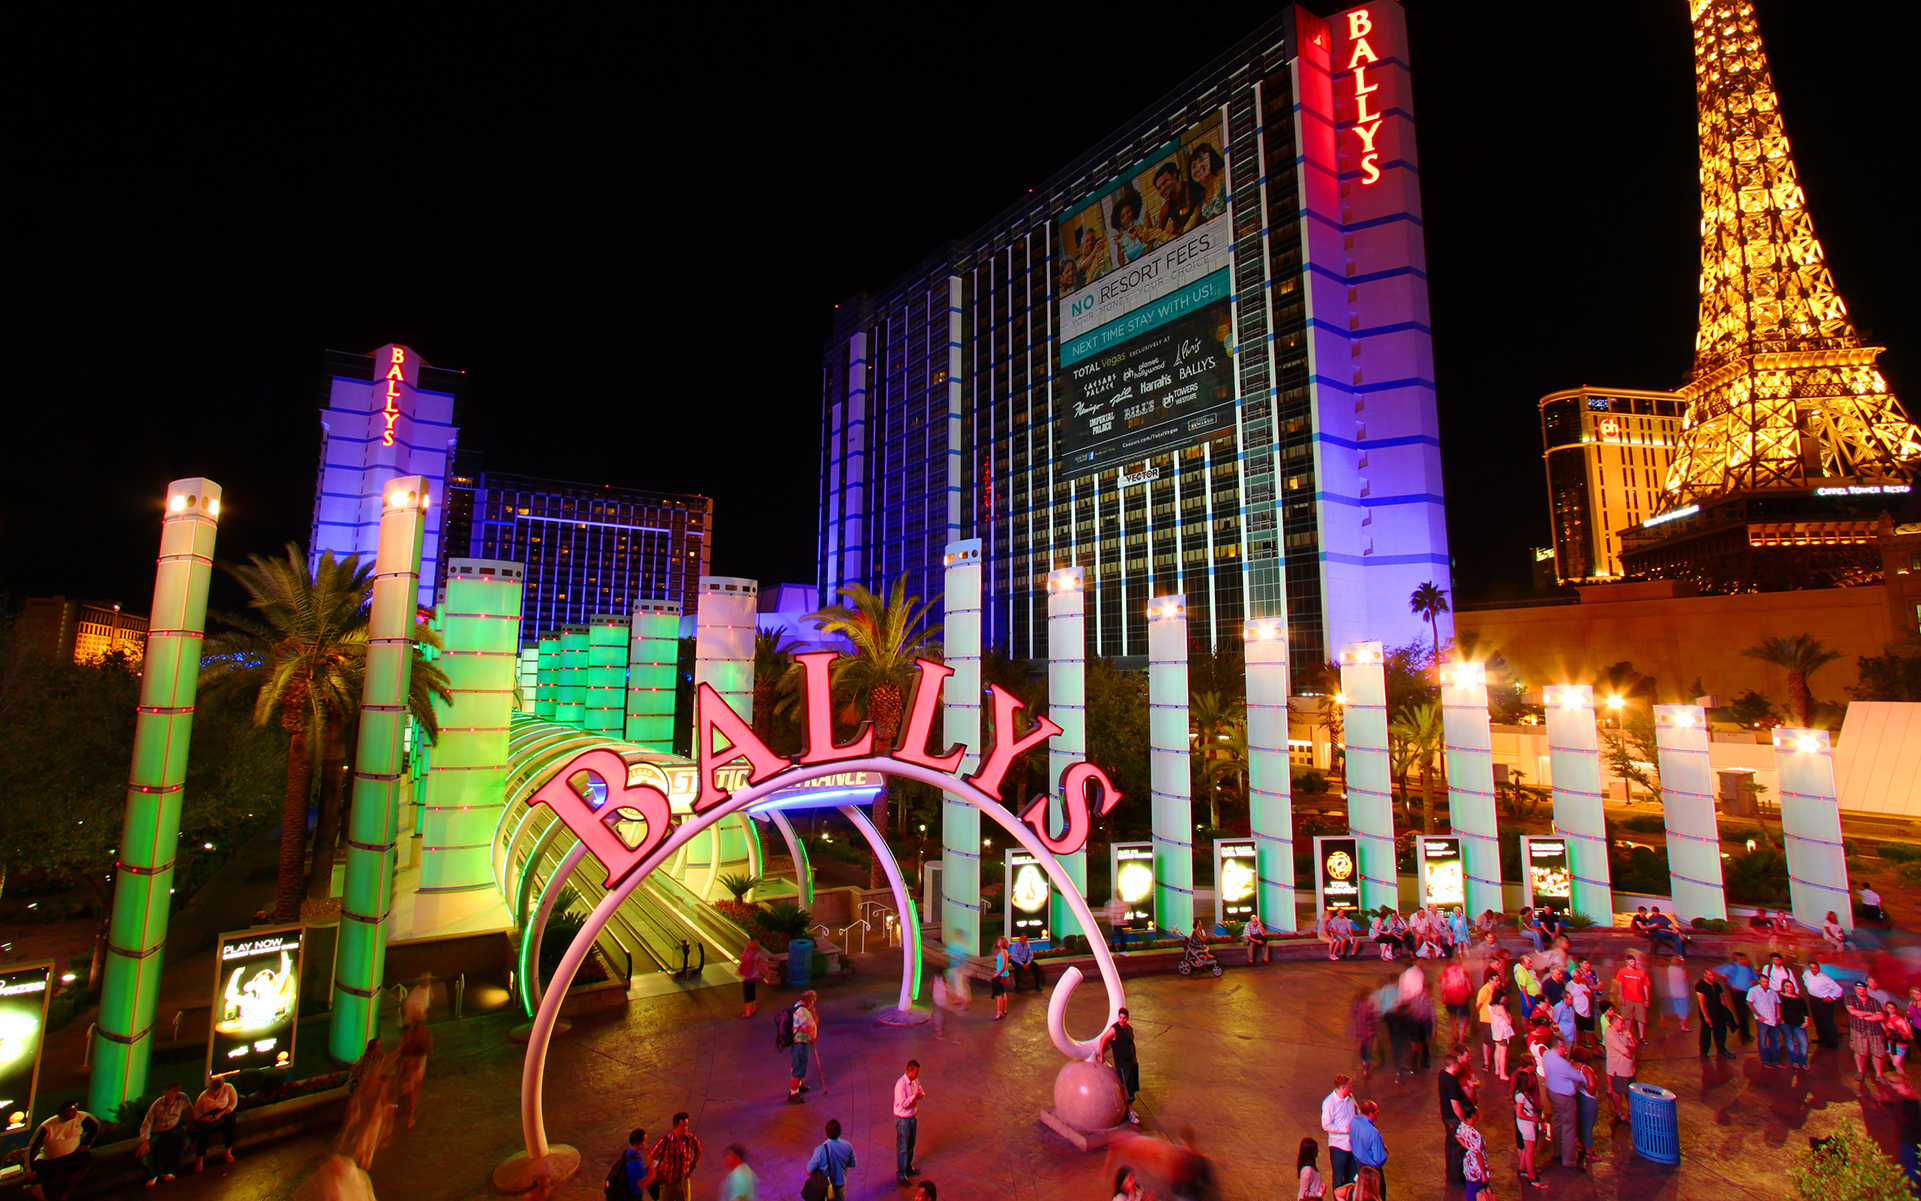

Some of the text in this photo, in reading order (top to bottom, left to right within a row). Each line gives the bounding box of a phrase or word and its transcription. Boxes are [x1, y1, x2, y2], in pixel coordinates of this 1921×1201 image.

[1072, 234, 1210, 317] NO RESORT FEES
[1072, 312, 1094, 328] YOUR
[1139, 277, 1164, 295] YOUR
[1171, 254, 1210, 280] CHOICE
[1073, 283, 1213, 357] NEXT TIME STAY WITH US!
[1181, 337, 1202, 359] Paris
[1073, 362, 1101, 379] TOTAL
[1101, 352, 1126, 368] Vegas
[1129, 339, 1162, 357] EXCLUSIVELY
[1139, 357, 1159, 372] planet
[1179, 356, 1216, 380] BALLY'S
[1133, 361, 1166, 379] hollywood
[1084, 373, 1116, 391] CAESARS
[1086, 381, 1114, 398] PALACE
[1140, 374, 1172, 394] Harrah's
[1173, 382, 1199, 398] TOWERS
[382, 347, 404, 447] BALLYS
[1109, 386, 1133, 407] Rio
[1089, 412, 1115, 428] IMPERIAL
[1092, 421, 1112, 435] PALACE
[1122, 428, 1179, 448] Caesars.com/TotalVegas
[1126, 468, 1159, 483] VECTOR
[1848, 485, 1882, 495] TOWER
[527, 651, 1123, 889] BALLYS
[222, 942, 253, 954] PLAY
[254, 937, 283, 949] NOW
